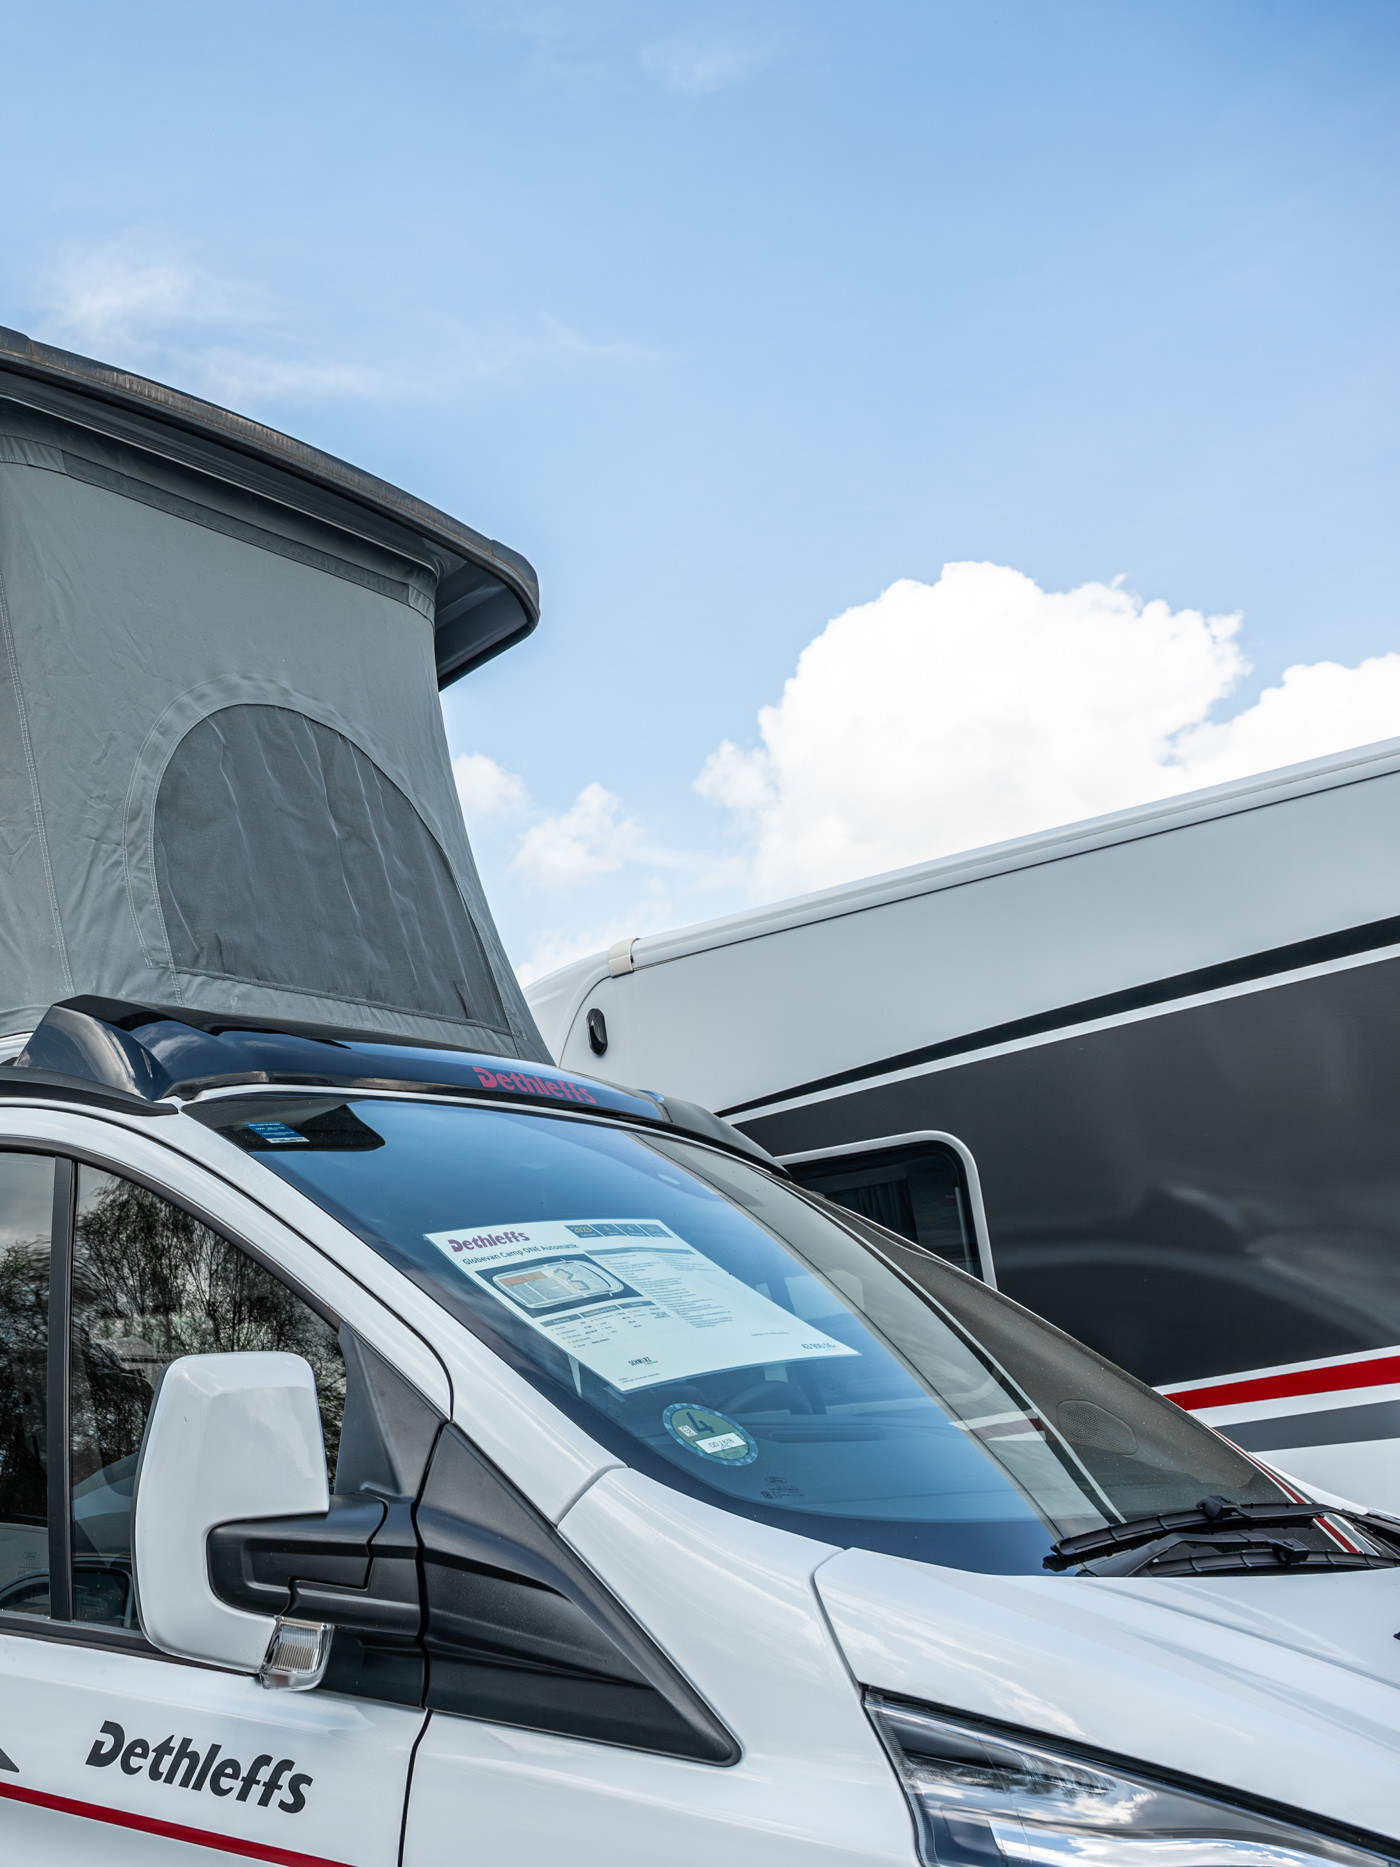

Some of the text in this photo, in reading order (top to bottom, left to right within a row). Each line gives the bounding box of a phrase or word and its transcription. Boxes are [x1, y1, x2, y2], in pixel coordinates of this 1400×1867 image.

[472, 1066, 597, 1104] Dethleffs
[447, 1231, 530, 1253] Dethleffs
[462, 1243, 579, 1265] Globevan Camp ONE Automatik
[686, 1411, 716, 1434] 4
[85, 1720, 314, 1814] Dethleffs
